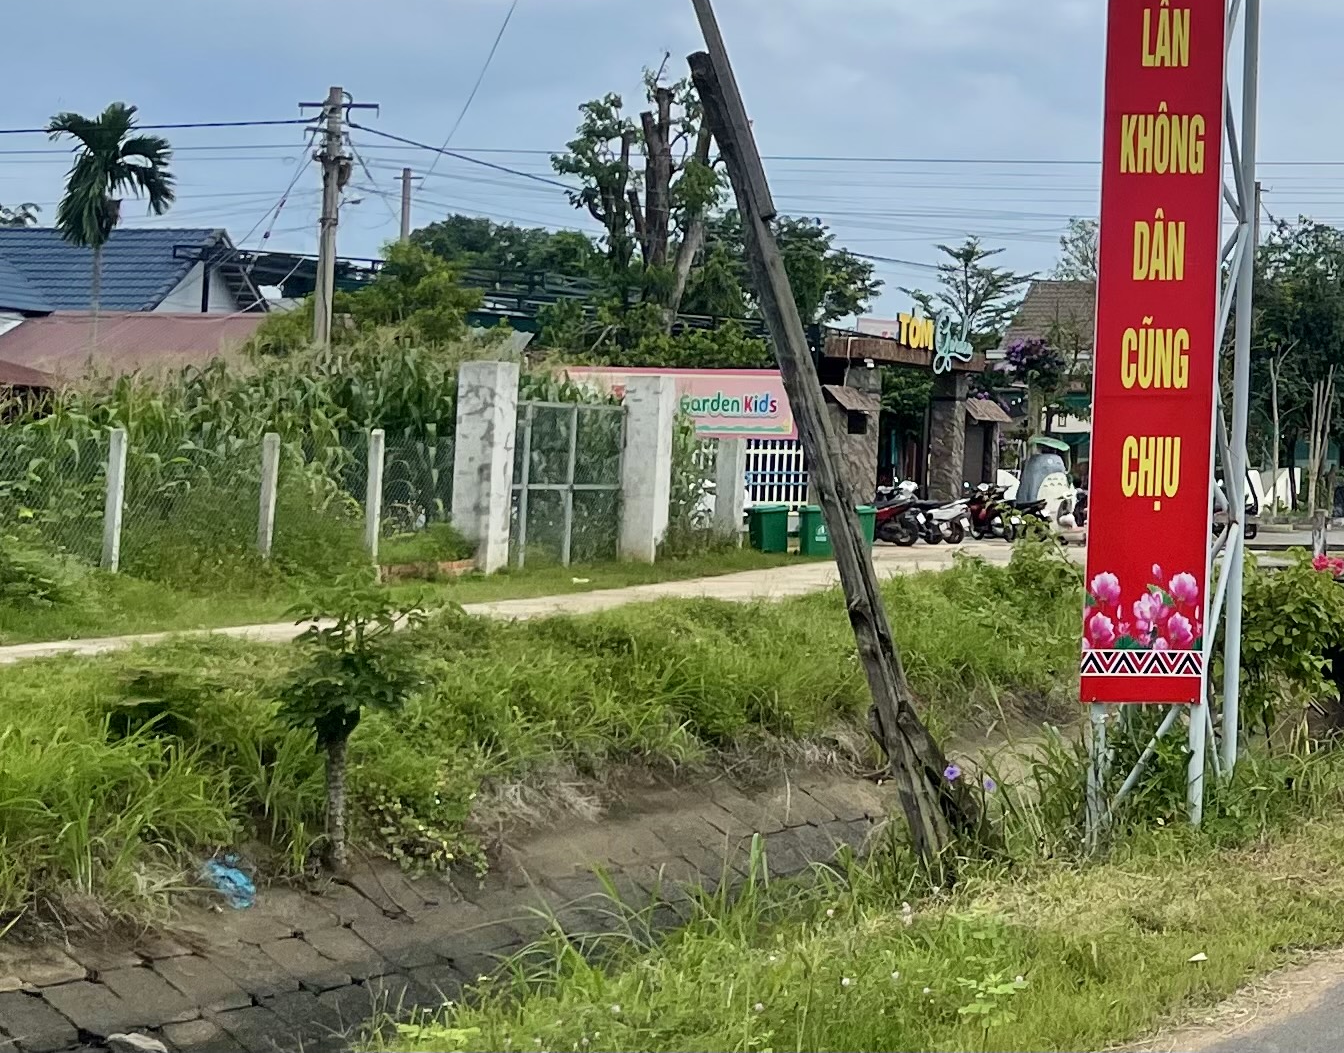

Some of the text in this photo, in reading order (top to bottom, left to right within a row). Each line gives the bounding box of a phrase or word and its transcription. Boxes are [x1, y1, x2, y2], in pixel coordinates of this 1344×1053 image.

[1120, 102, 1205, 174] KHÔNG
[1132, 209, 1185, 281] DÂN
[1120, 316, 1190, 389] CŨNG
[679, 392, 778, 414] Garden Kids
[1121, 435, 1181, 511] CHỊU
